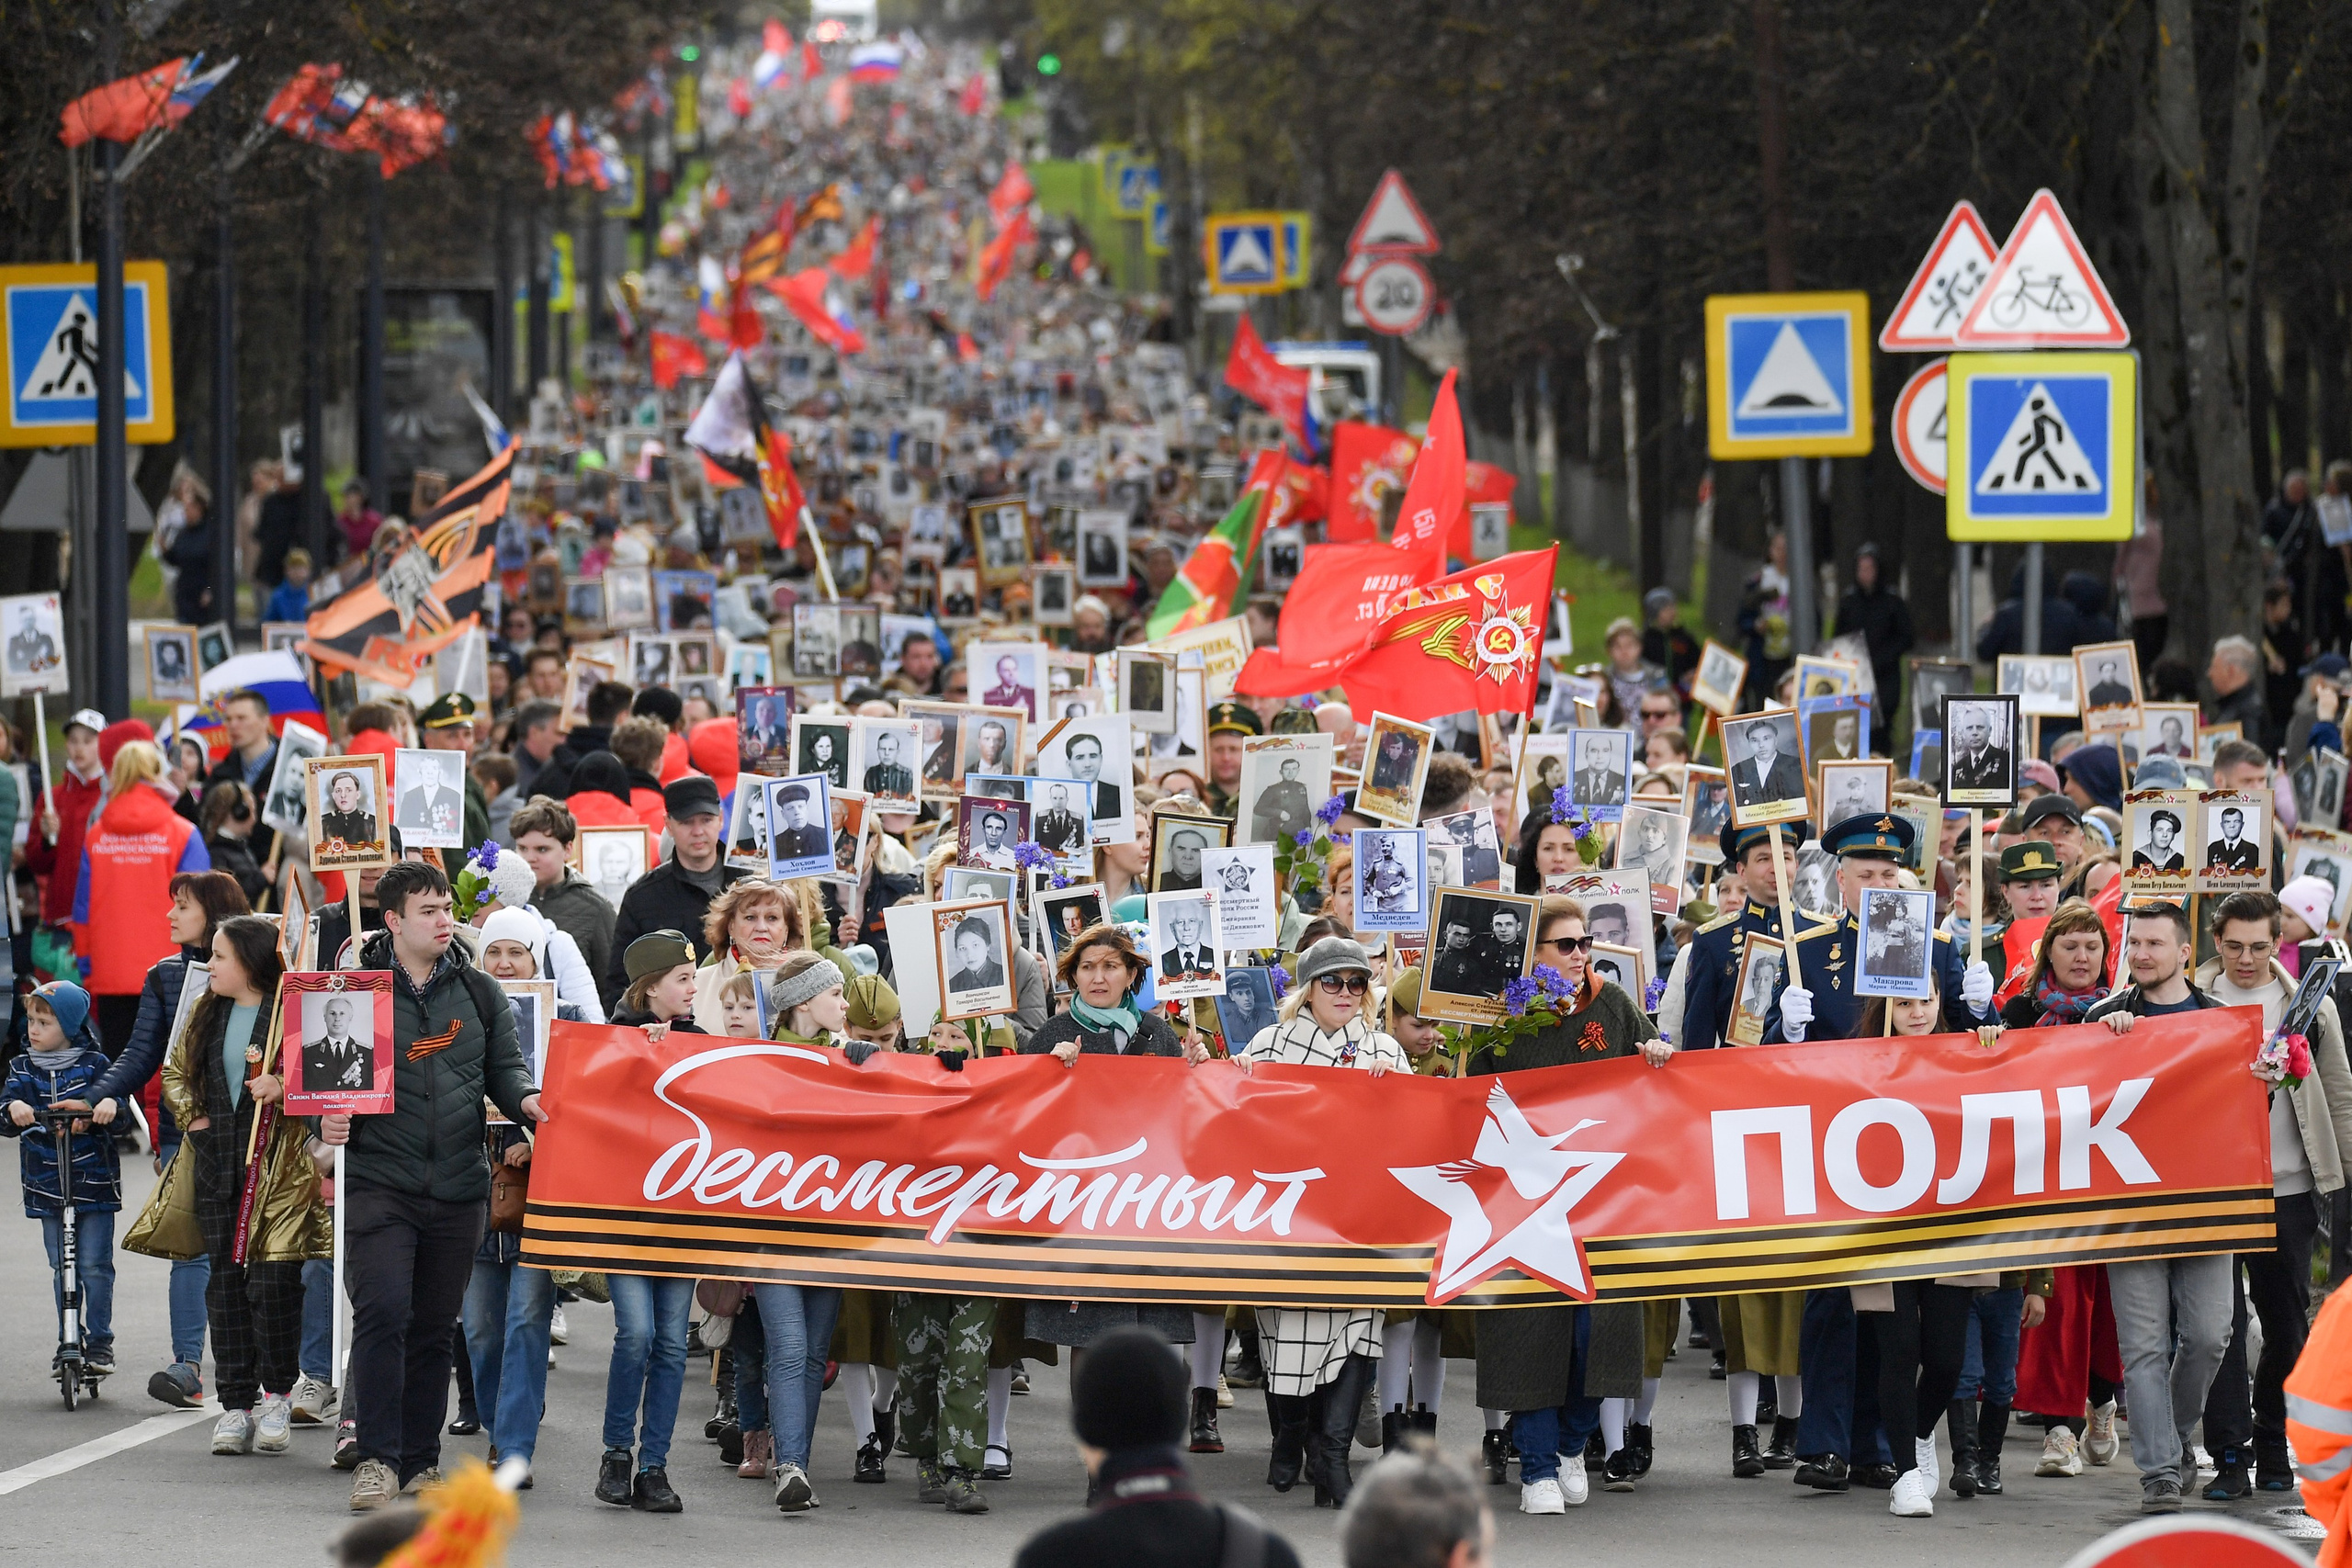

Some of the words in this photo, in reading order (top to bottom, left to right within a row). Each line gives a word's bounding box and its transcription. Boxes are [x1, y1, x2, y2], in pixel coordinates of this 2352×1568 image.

[1376, 279, 1417, 309] 20
[790, 860, 816, 868] Хохлов
[1220, 897, 1260, 906] ессмертный
[1873, 977, 1913, 986] Макарова
[311, 1092, 339, 1100] Василий
[342, 1092, 390, 1100] Владимирович
[1710, 1077, 2162, 1220] ПОЛК
